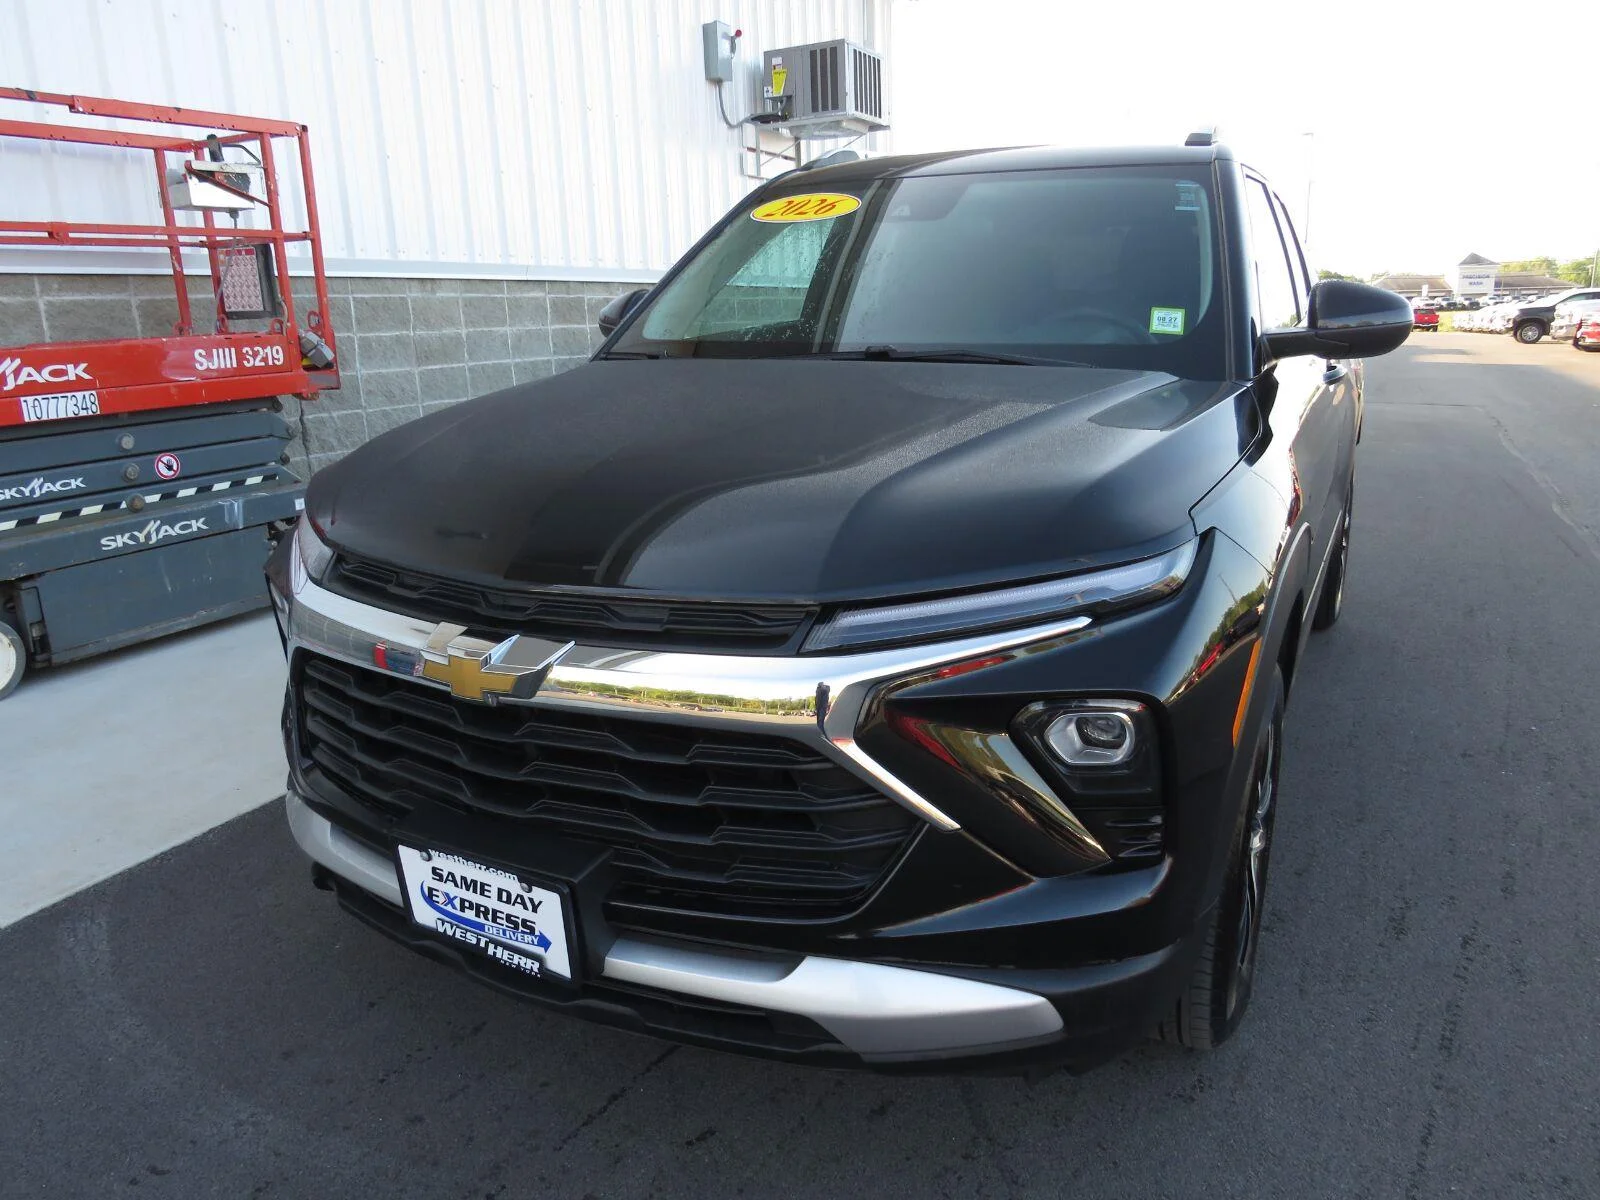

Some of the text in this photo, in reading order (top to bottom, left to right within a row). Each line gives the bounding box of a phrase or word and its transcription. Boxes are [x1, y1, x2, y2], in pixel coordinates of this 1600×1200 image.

[761, 198, 850, 217] 2026
[242, 345, 284, 368] 3219
[23, 393, 98, 421] 10777348
[100, 517, 209, 551] SKYJACK
[431, 866, 543, 914] SAME DAY
[427, 885, 536, 936] EXPRESS
[484, 924, 539, 945] DELIVERY
